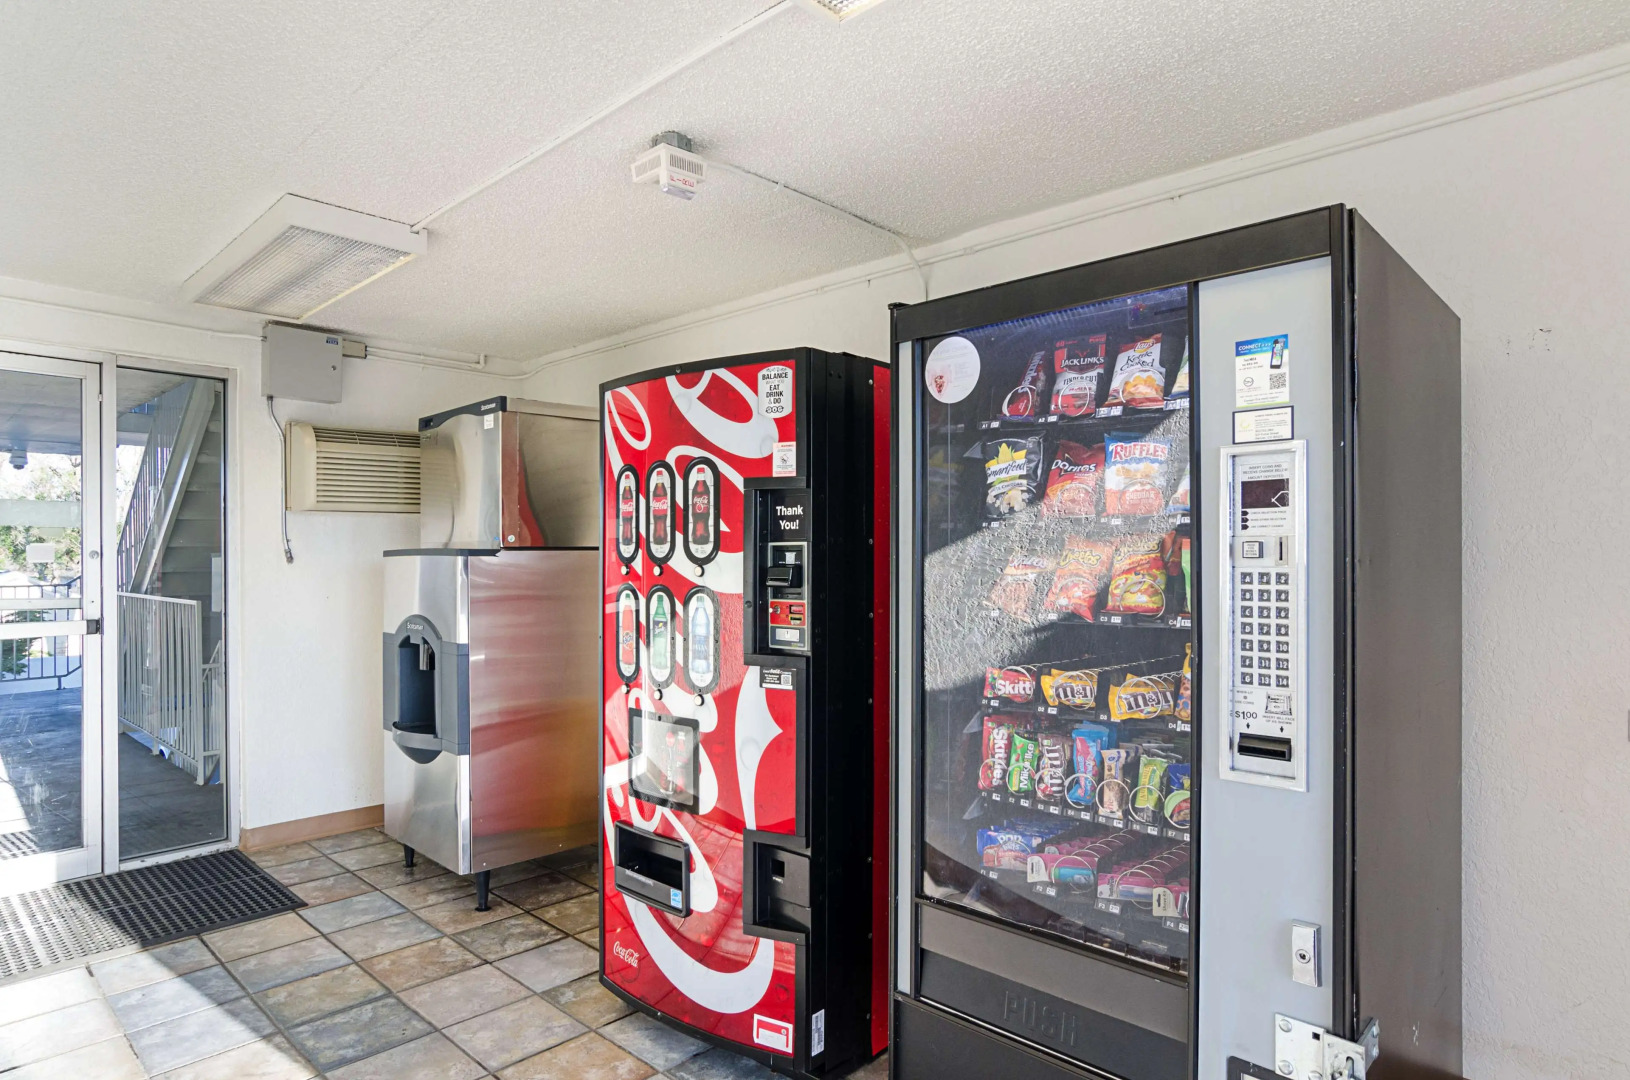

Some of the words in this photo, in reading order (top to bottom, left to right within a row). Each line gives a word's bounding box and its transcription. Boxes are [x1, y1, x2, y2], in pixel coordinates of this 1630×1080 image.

[762, 372, 788, 380] BALANCE
[766, 390, 784, 398] DRINK
[1109, 442, 1168, 462] RUFFLES
[776, 504, 803, 518] Thank
[779, 519, 800, 530] You!
[1003, 990, 1077, 1048] PUSH
